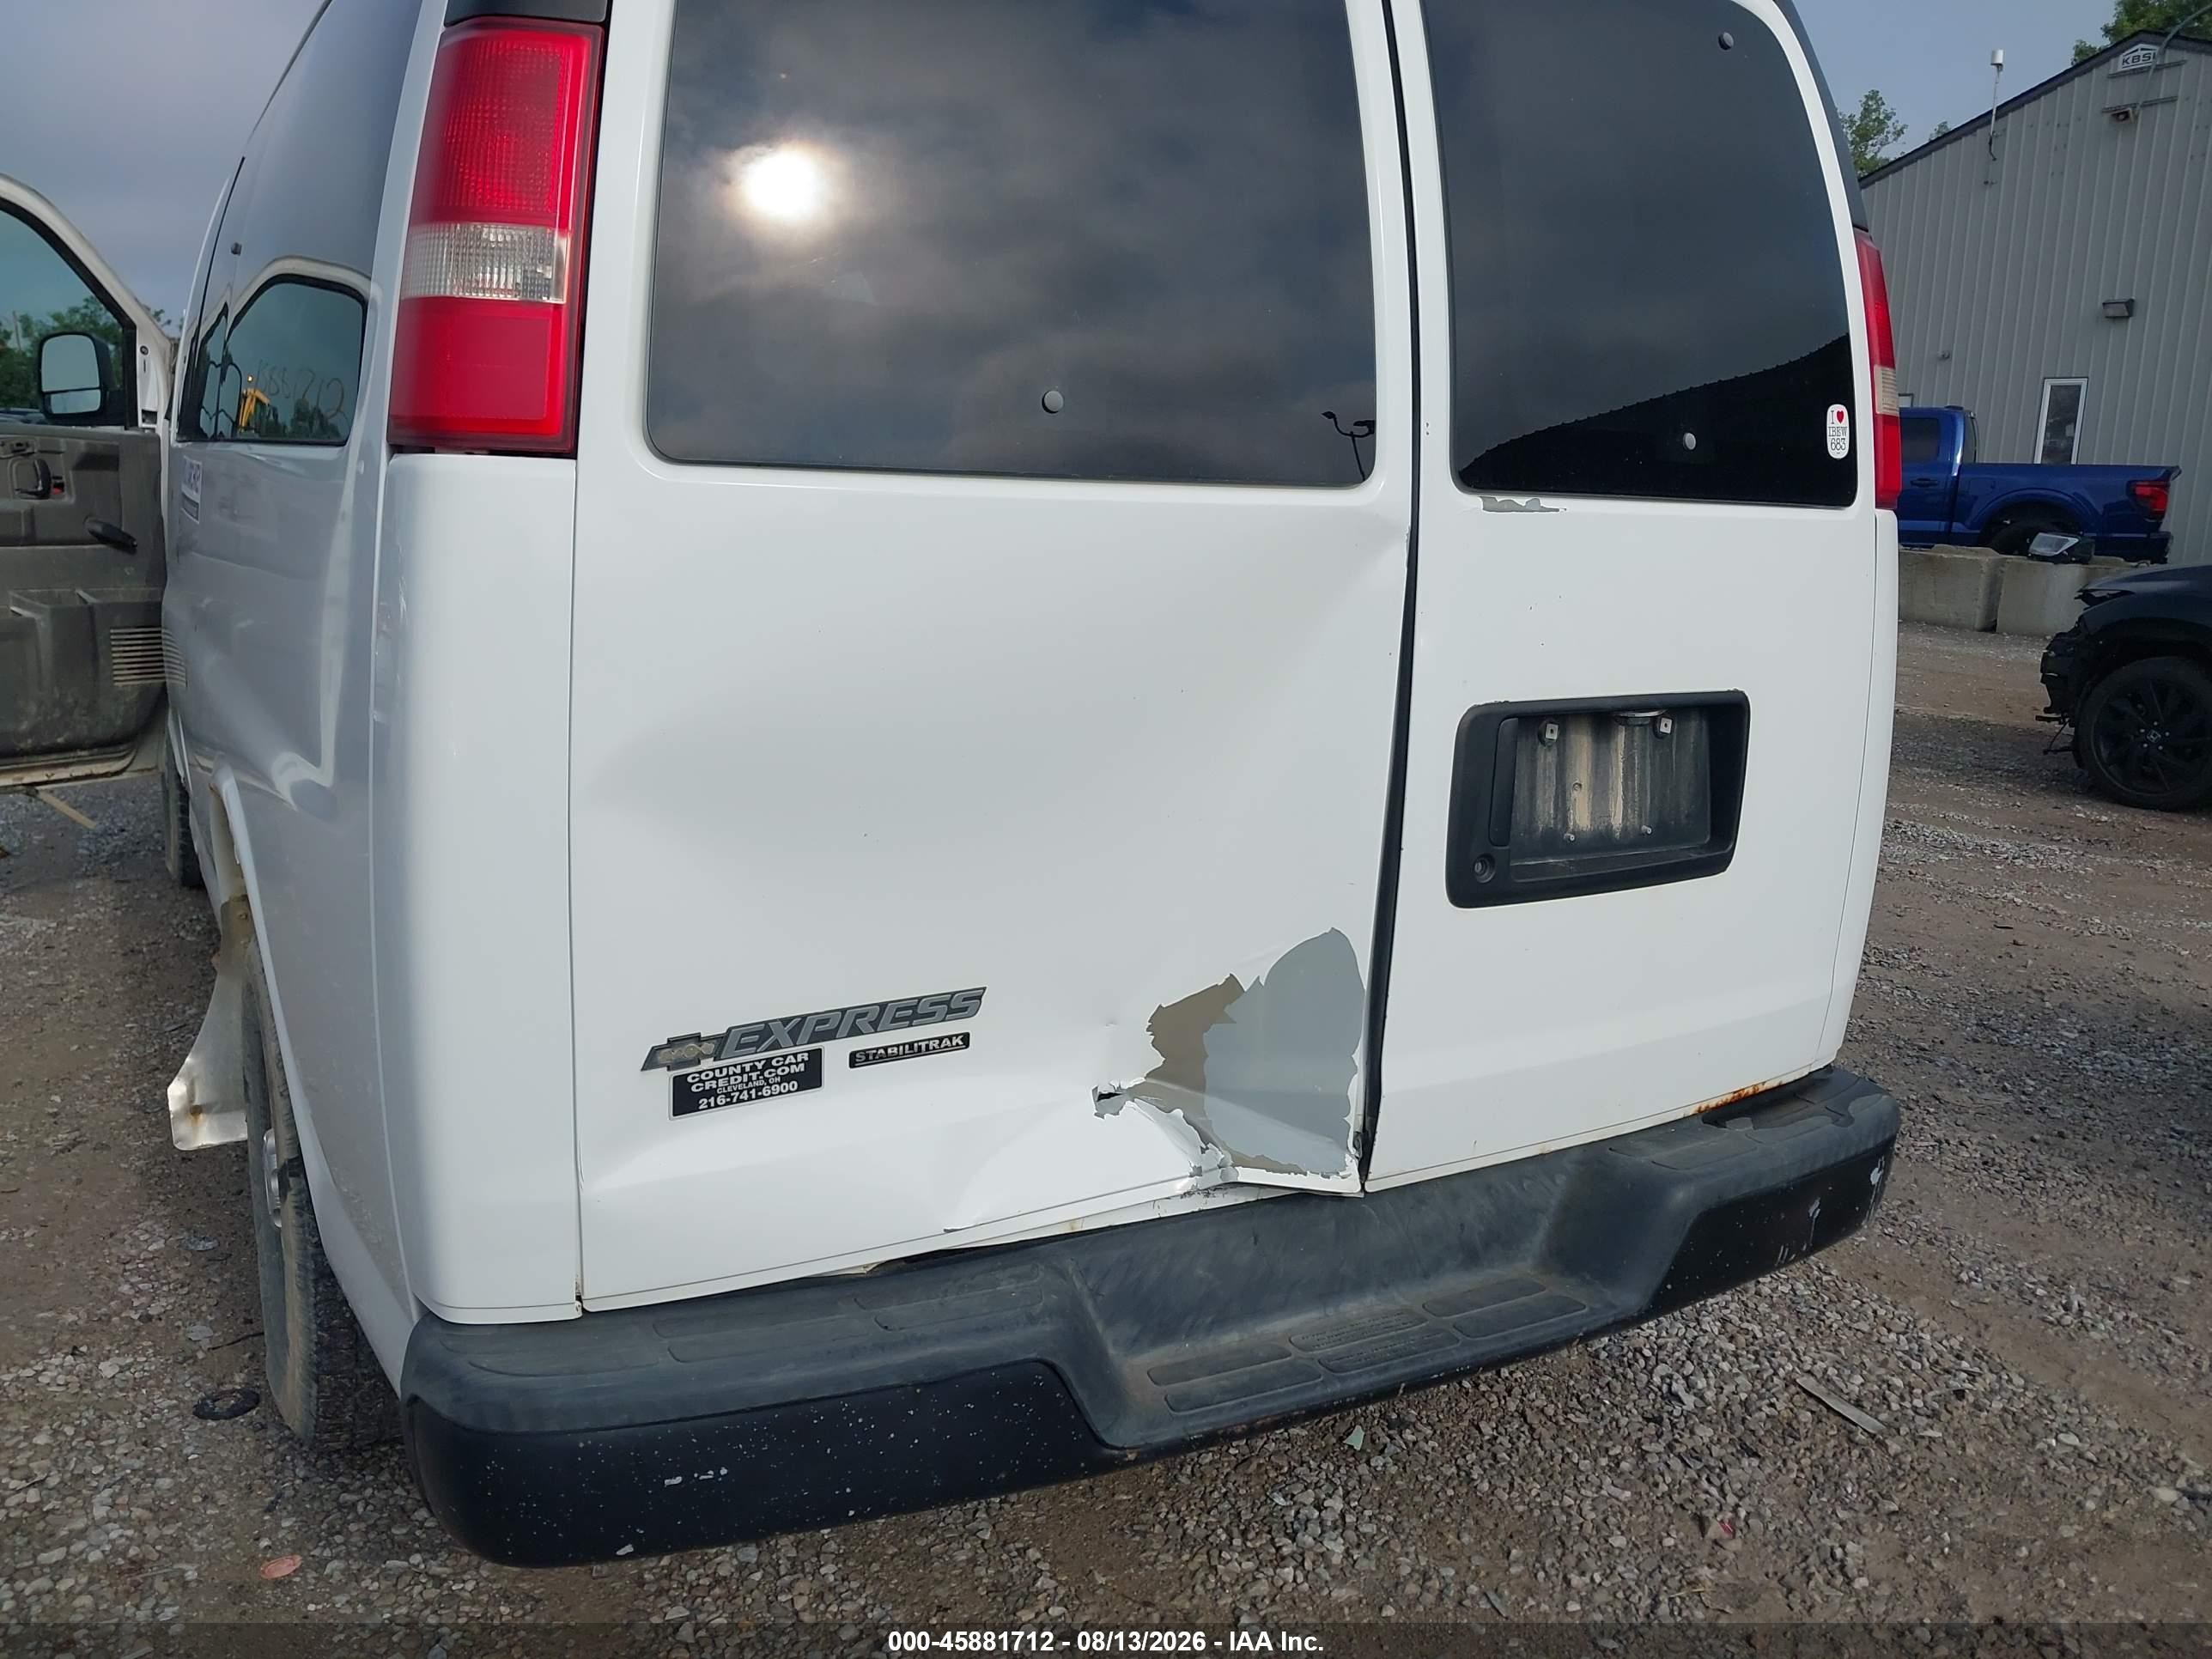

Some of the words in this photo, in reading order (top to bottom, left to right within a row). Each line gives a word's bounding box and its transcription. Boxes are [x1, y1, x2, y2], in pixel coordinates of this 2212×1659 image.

[1831, 410, 1835, 424] I
[1828, 426, 1848, 437] IBEW
[1830, 437, 1846, 451] 683
[720, 989, 985, 1059] EXPRESS
[854, 1035, 964, 1063] STABILITRAK
[687, 1059, 767, 1084] COUNTY
[771, 1052, 810, 1066] CAR
[690, 1062, 805, 1093] CREDIT.COM
[697, 1080, 799, 1110] 216-741-6900
[716, 1079, 768, 1095] CLEVELAND,
[769, 1075, 781, 1085] OH
